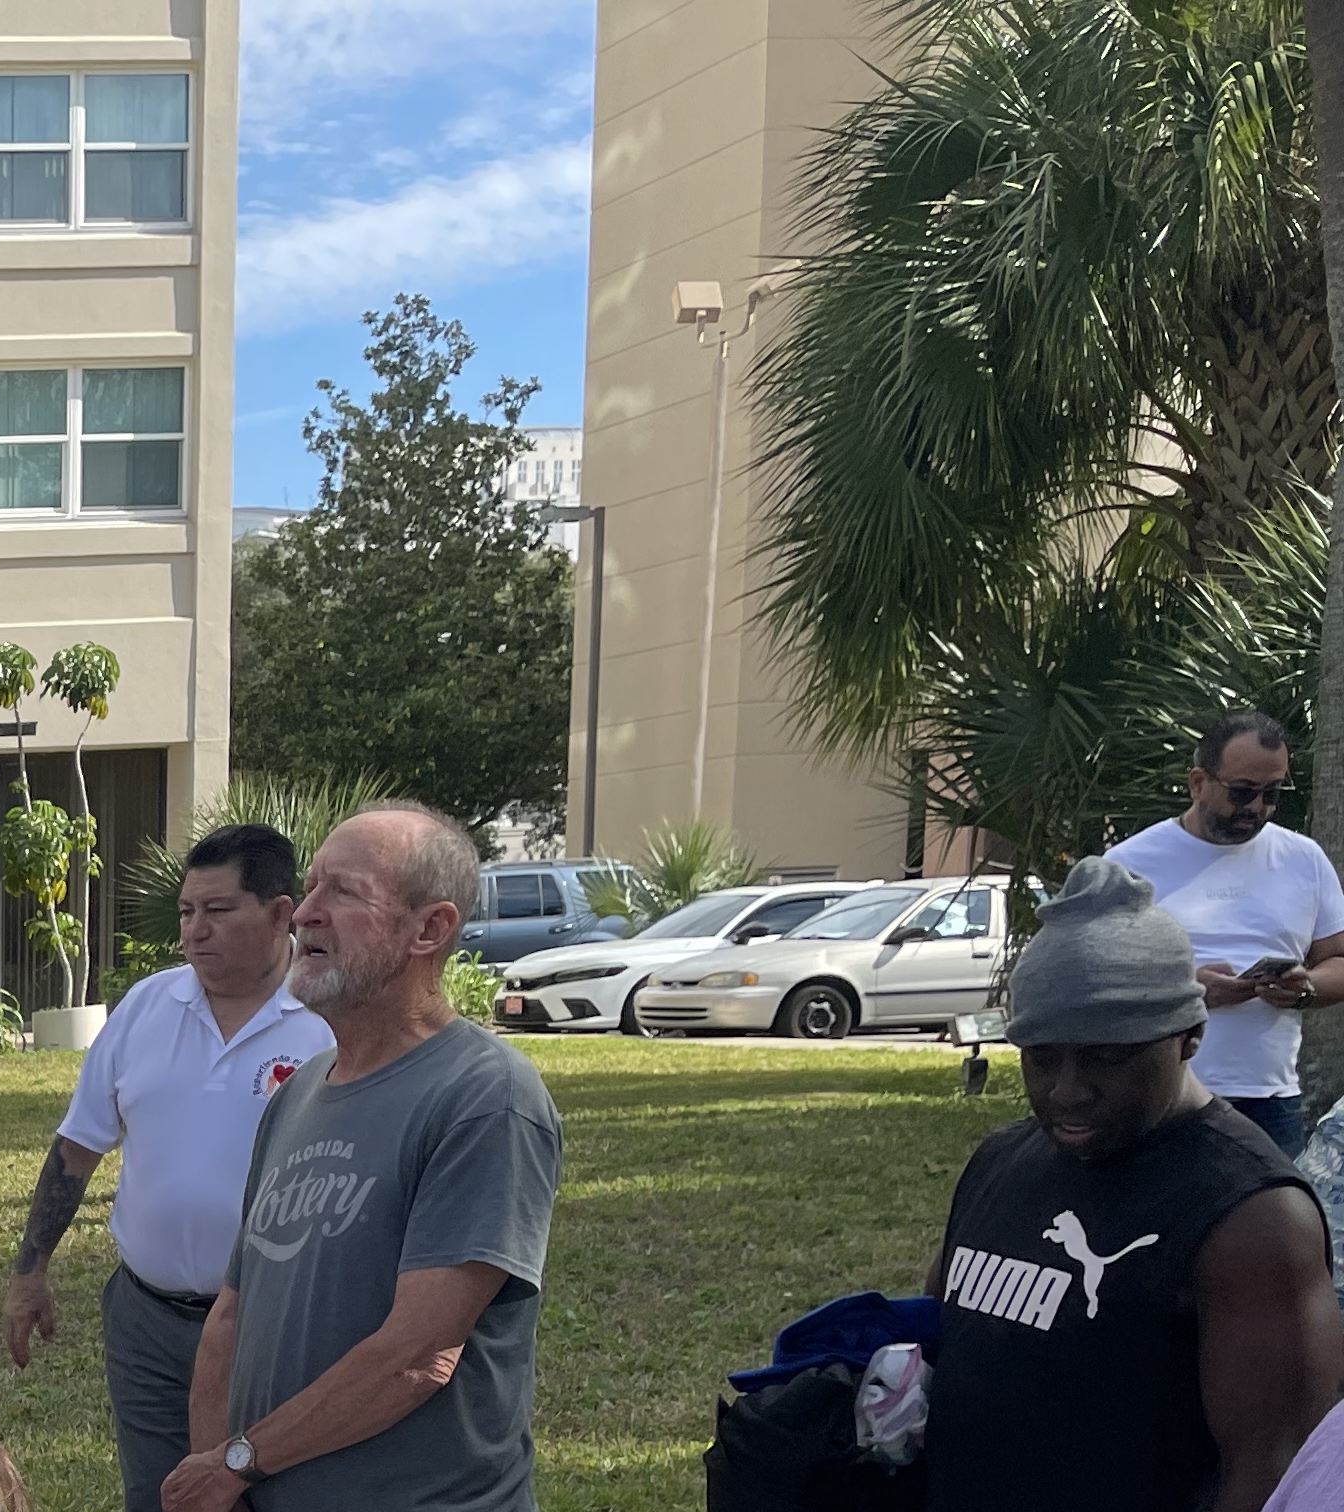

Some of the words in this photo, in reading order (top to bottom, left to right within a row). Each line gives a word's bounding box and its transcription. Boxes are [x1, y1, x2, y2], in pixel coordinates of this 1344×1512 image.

[287, 1139, 355, 1169] FLORIDA
[244, 1166, 378, 1262] Lottery
[943, 1246, 1073, 1332] PUMA
